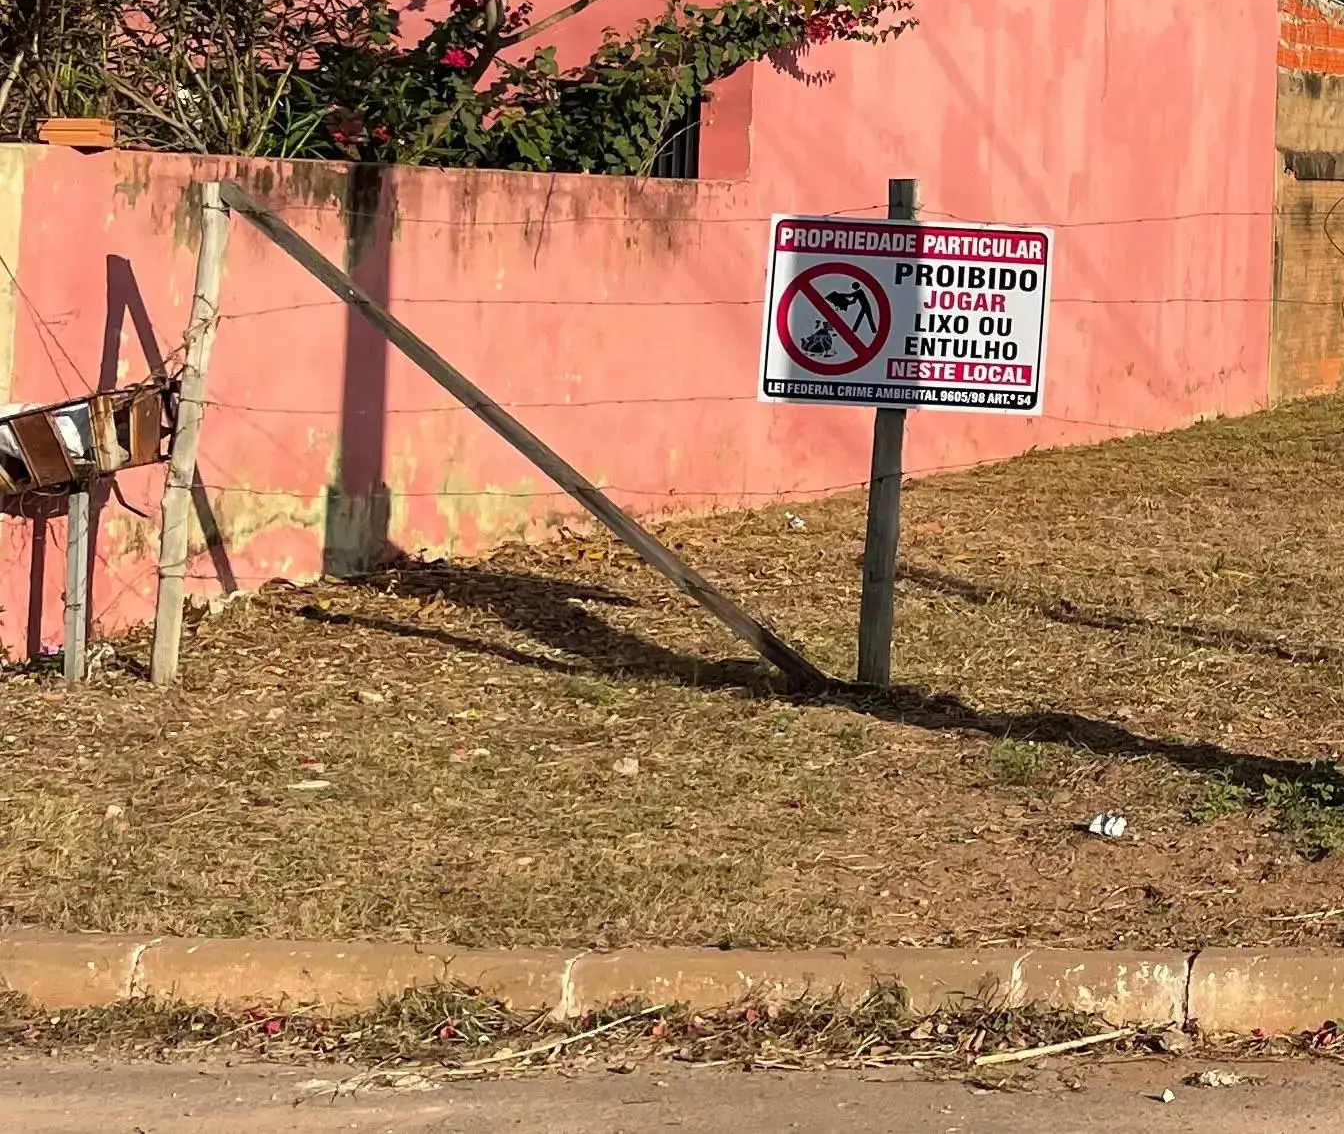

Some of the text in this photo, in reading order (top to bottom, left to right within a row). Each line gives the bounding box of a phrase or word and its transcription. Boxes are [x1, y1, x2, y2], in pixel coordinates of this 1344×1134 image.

[779, 226, 1043, 260] PROPRIEDADE PARTICULAR
[894, 262, 1038, 292] PROIBIDO
[923, 290, 1006, 313] JOGAR
[914, 313, 1012, 337] LIXO OU
[904, 336, 1018, 361] ENTULHO
[890, 360, 1027, 384] NESTE LOCAL
[768, 381, 785, 394] LEI
[786, 382, 835, 397] FEDERAL
[837, 385, 874, 398] CRIME
[875, 387, 939, 402] AMBIENTAL
[940, 390, 986, 404] 9605/98
[1017, 394, 1032, 406] 54
